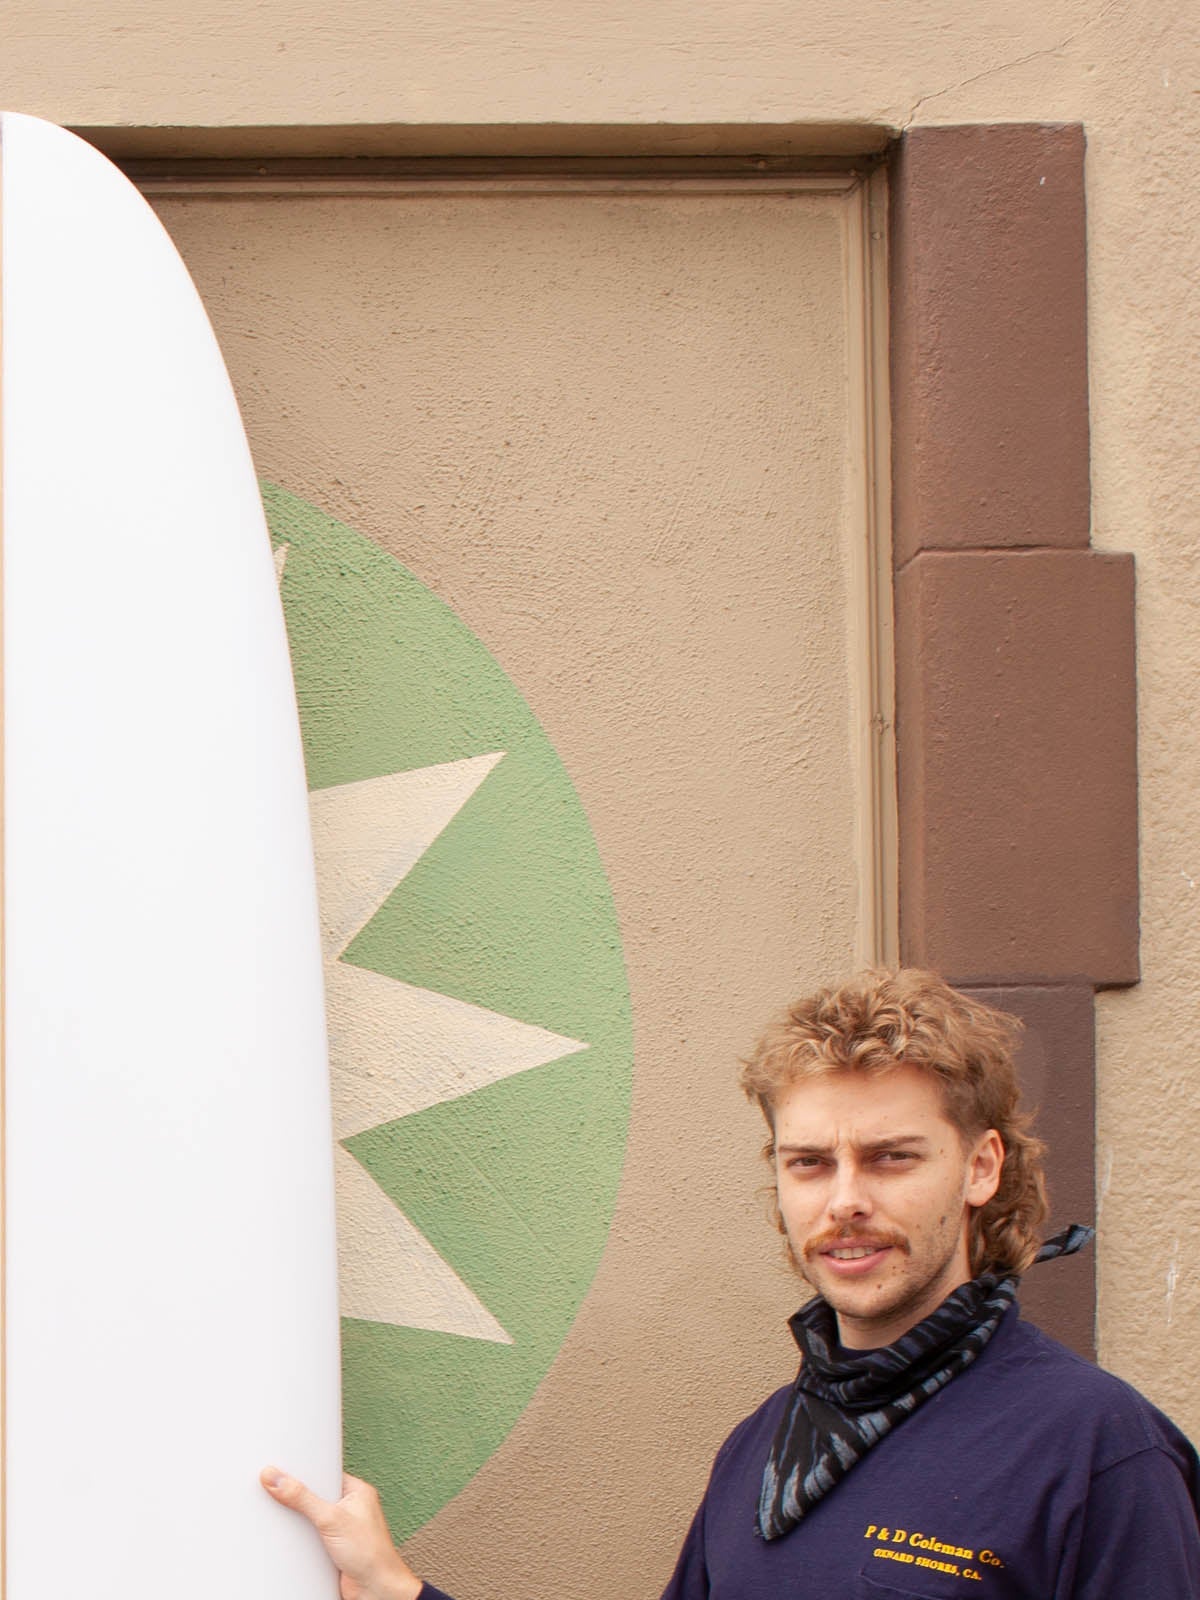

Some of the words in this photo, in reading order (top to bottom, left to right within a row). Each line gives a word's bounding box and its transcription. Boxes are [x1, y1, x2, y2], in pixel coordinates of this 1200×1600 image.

[877, 1527, 890, 1541] &
[892, 1529, 908, 1543] D
[909, 1533, 974, 1560] Coleman
[978, 1549, 1005, 1569] Co.
[915, 1556, 960, 1577] SHORES,
[962, 1568, 983, 1581] CA.
